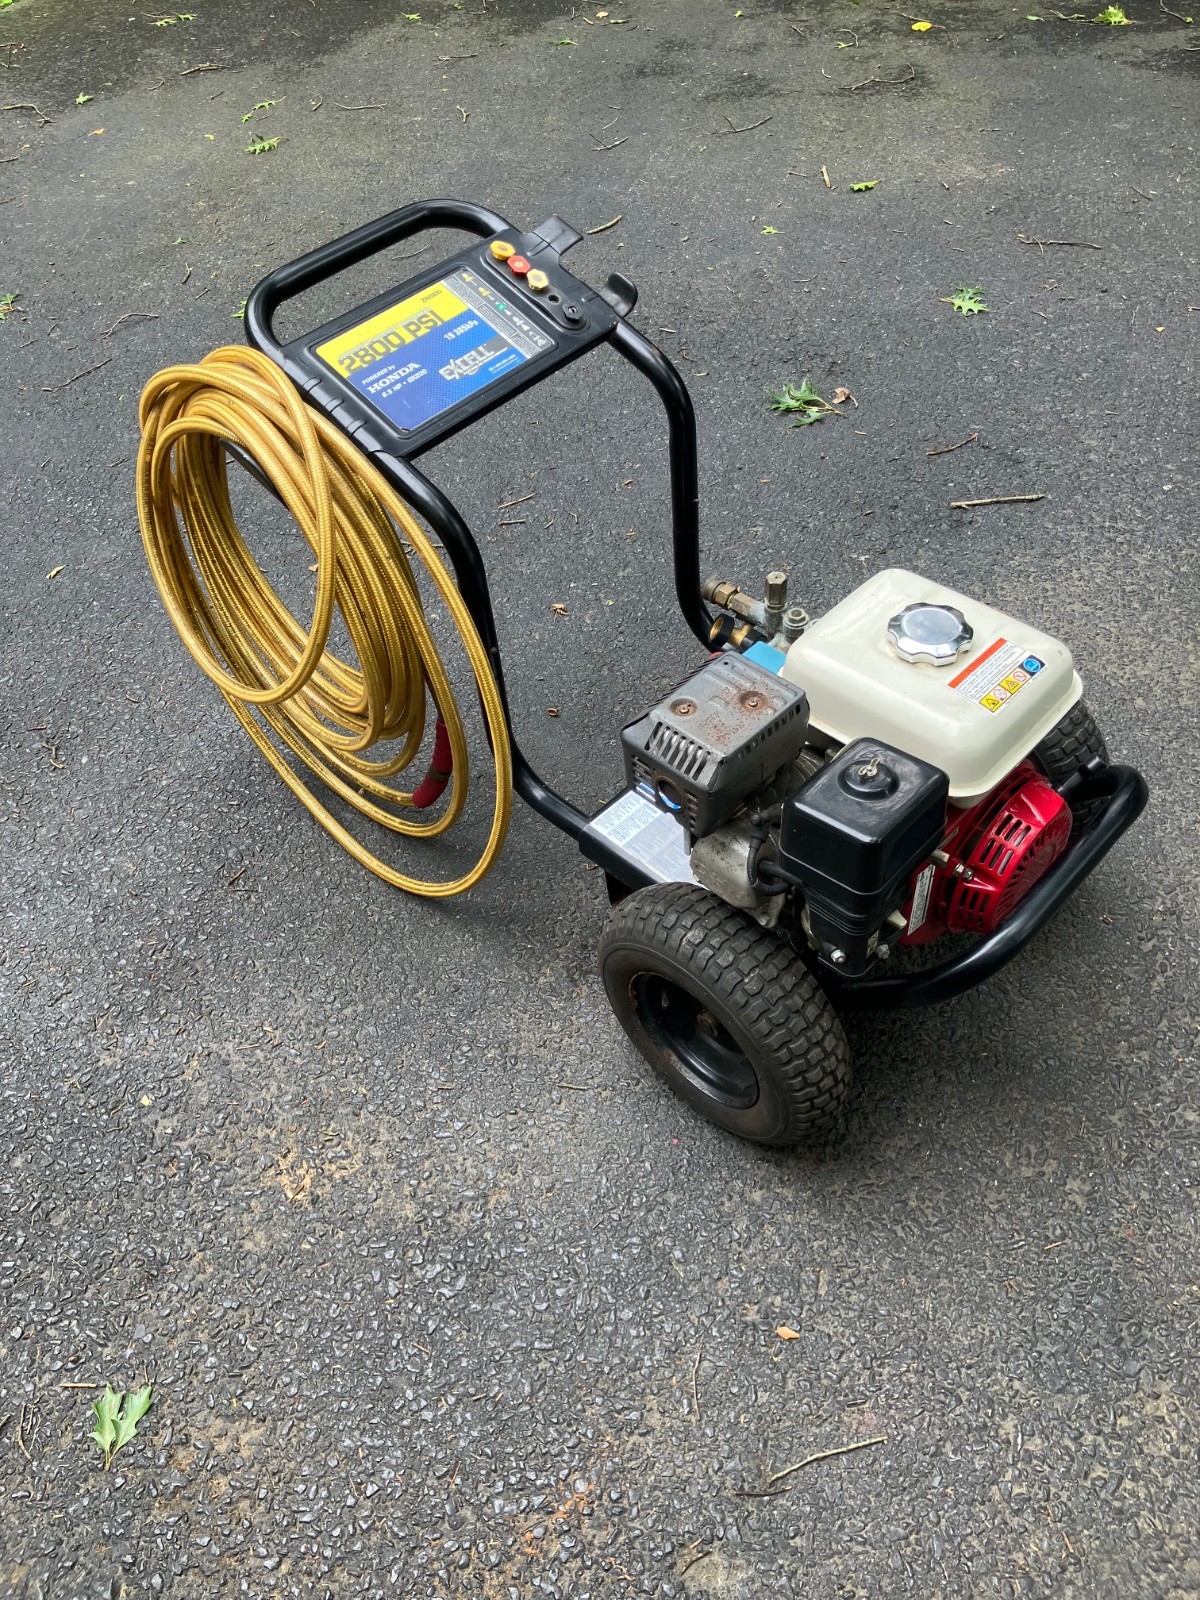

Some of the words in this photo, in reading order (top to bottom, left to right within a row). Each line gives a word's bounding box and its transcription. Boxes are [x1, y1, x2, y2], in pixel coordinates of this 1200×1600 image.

[338, 331, 407, 374] 2800
[402, 310, 446, 339] PSI
[444, 332, 455, 341] 19
[439, 345, 494, 380] EXCELL
[362, 368, 387, 385] POWERED
[367, 362, 421, 393] HONDA
[392, 383, 403, 391] HP
[407, 369, 427, 383] GX200
